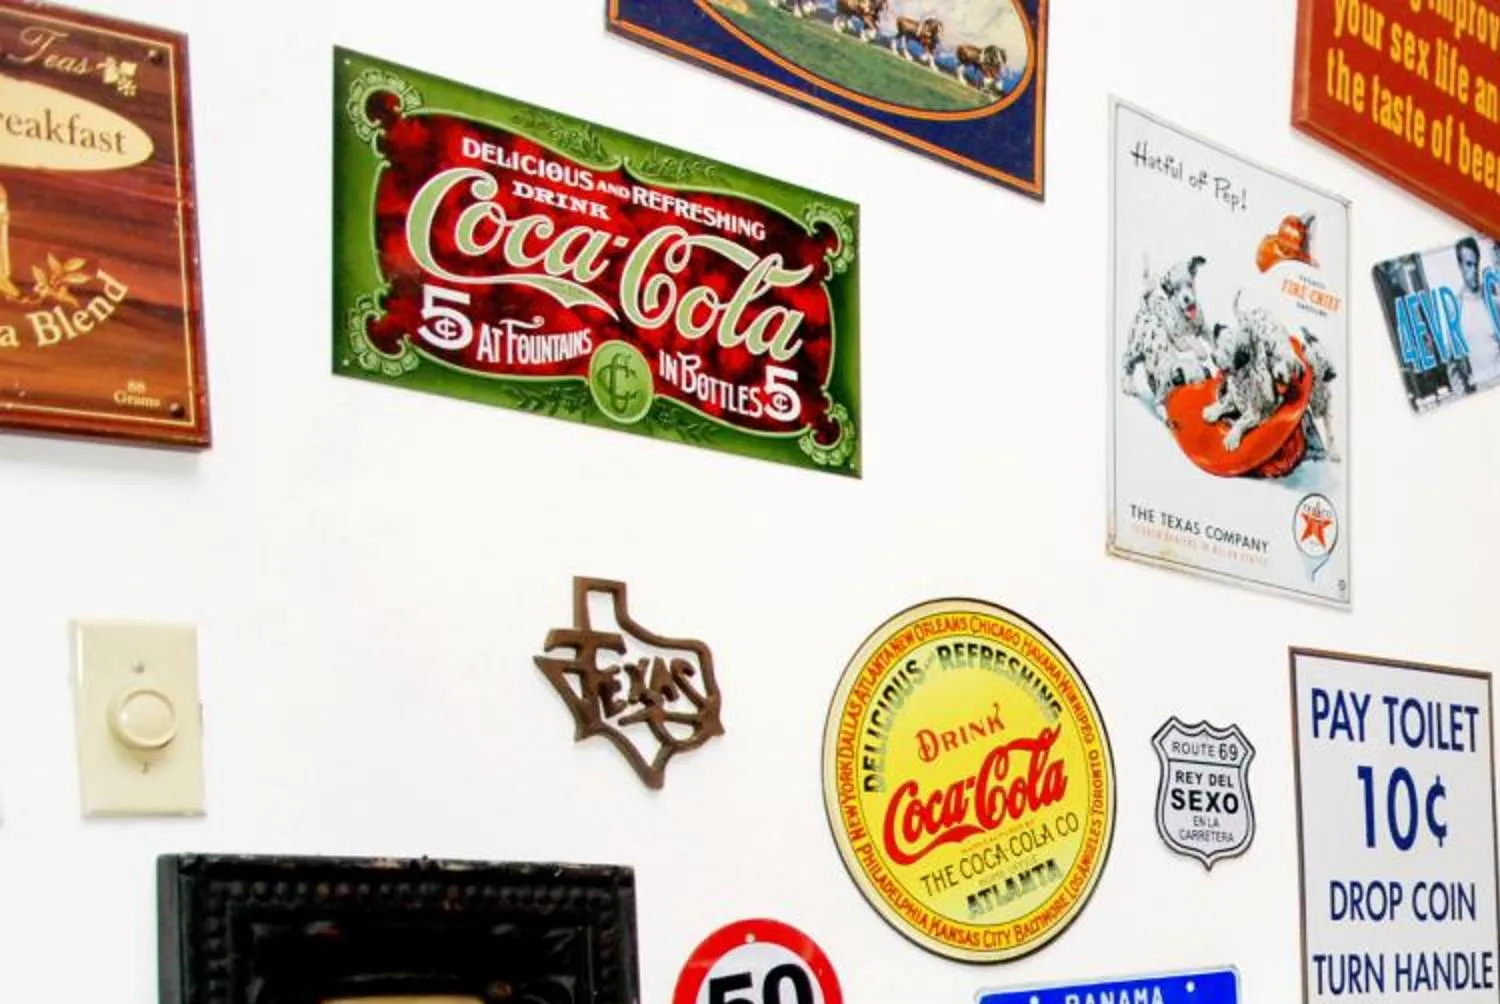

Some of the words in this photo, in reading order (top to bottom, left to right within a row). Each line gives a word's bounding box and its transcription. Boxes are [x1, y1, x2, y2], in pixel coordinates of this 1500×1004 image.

[7, 25, 93, 76] Teas
[1333, 0, 1385, 50] your
[1390, 22, 1430, 80] sex
[1435, 37, 1469, 104] life
[1327, 47, 1365, 114] the
[1371, 75, 1426, 149] taste
[1431, 114, 1453, 165] of
[462, 136, 595, 192] DELICIOUS
[596, 180, 632, 203] AND
[631, 185, 767, 241] REFRESHING
[512, 181, 611, 221] DRINK
[1130, 139, 1184, 186] Hatful
[1189, 167, 1208, 191] of
[1213, 176, 1248, 210] Pep!
[405, 166, 814, 361] Coca-Cola
[26, 268, 129, 347] Blend
[1394, 285, 1470, 372] 4EVR
[476, 329, 502, 364] AT
[499, 315, 593, 367] FOUNTAINS
[659, 349, 680, 382] IN
[678, 350, 763, 419] BOTTLES
[1131, 503, 1156, 524] THE
[1160, 511, 1201, 536] TEXAS
[1205, 524, 1272, 554] COMPANY
[863, 659, 923, 793] DELICIOUS
[936, 642, 1063, 720] REFRESHING
[915, 702, 1005, 763] DRINK
[1311, 687, 1371, 743] PAY
[1382, 695, 1480, 753] TOILET
[1172, 741, 1216, 758] ROUTE
[1218, 743, 1239, 762] 69
[1175, 770, 1203, 786] REY
[1208, 773, 1235, 788] DEL
[855, 644, 894, 706] ATLANTA
[983, 928, 1011, 949] CITY
[884, 723, 1070, 867] Coca-Cola
[1171, 788, 1239, 815] SEXO
[1207, 816, 1220, 829] LA
[1357, 765, 1448, 851] 10¢
[920, 863, 960, 897] THE
[1056, 811, 1079, 841] CO
[1178, 828, 1235, 843] CARRETERA
[966, 858, 1063, 917] ATLANTA
[1329, 880, 1402, 922] DROP
[1412, 881, 1476, 922] COIN
[1313, 953, 1385, 996] TURN
[1395, 951, 1495, 993] HANDLE
